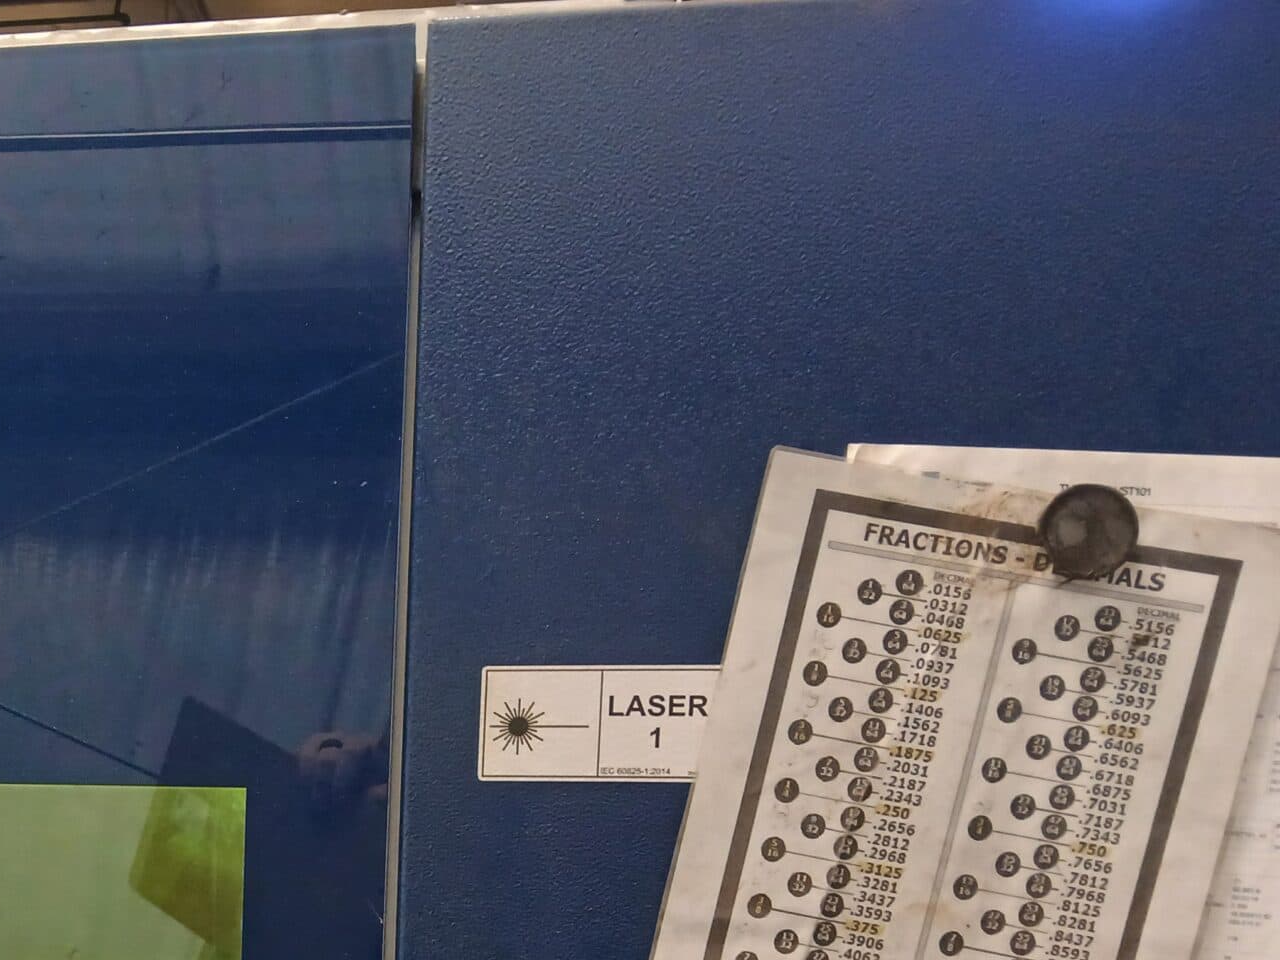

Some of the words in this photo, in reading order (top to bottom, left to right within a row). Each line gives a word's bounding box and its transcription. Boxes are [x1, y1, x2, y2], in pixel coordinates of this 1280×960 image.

[864, 522, 1008, 565] FRACTIONS
[928, 584, 972, 600] .0156
[924, 599, 968, 616] .0312
[921, 612, 965, 629] .0468
[1129, 618, 1175, 635] .5156
[918, 627, 962, 644] .0625
[1125, 633, 1172, 650] .12
[915, 641, 958, 659] .0781
[1121, 649, 1167, 666] .5468
[911, 658, 954, 674] .0937
[1117, 664, 1163, 680] .5625
[907, 673, 950, 689] .1093
[1113, 678, 1158, 696] .5781
[904, 688, 938, 702] .125
[1109, 693, 1156, 710] .5937
[608, 695, 708, 717] LASER
[901, 702, 943, 718] .1406
[897, 716, 940, 733] .1562
[1106, 709, 1151, 726] .6093
[650, 727, 661, 749] 1
[894, 730, 937, 747] .1718
[1101, 724, 1137, 739] .625
[890, 745, 933, 762] .1875
[1098, 738, 1143, 755] .6406
[886, 760, 929, 777] .2031
[1094, 753, 1139, 770] .6562
[883, 775, 926, 792] .2187
[1090, 770, 1135, 786] .6718
[880, 789, 922, 806] .2343
[1086, 783, 1132, 801] .6875
[876, 805, 910, 819] .250
[1083, 798, 1127, 815] .7031
[873, 819, 916, 836] .2656
[1078, 813, 1124, 831] .7187
[868, 833, 910, 850] .2812
[1076, 828, 1121, 845] .7343
[864, 848, 907, 864] .2968
[1072, 842, 1107, 857] .750
[860, 862, 902, 879] .3125
[1068, 856, 1112, 874] .7656
[856, 877, 898, 893] .3281
[1063, 872, 1108, 890] .7812
[853, 892, 896, 908] .3437
[1061, 887, 1106, 903] .7968
[850, 905, 892, 922] .3593
[1057, 900, 1101, 918] .8125
[846, 920, 879, 935] .375
[1052, 915, 1096, 932] .8281
[842, 934, 884, 950] .3906
[1048, 930, 1094, 947] .8437
